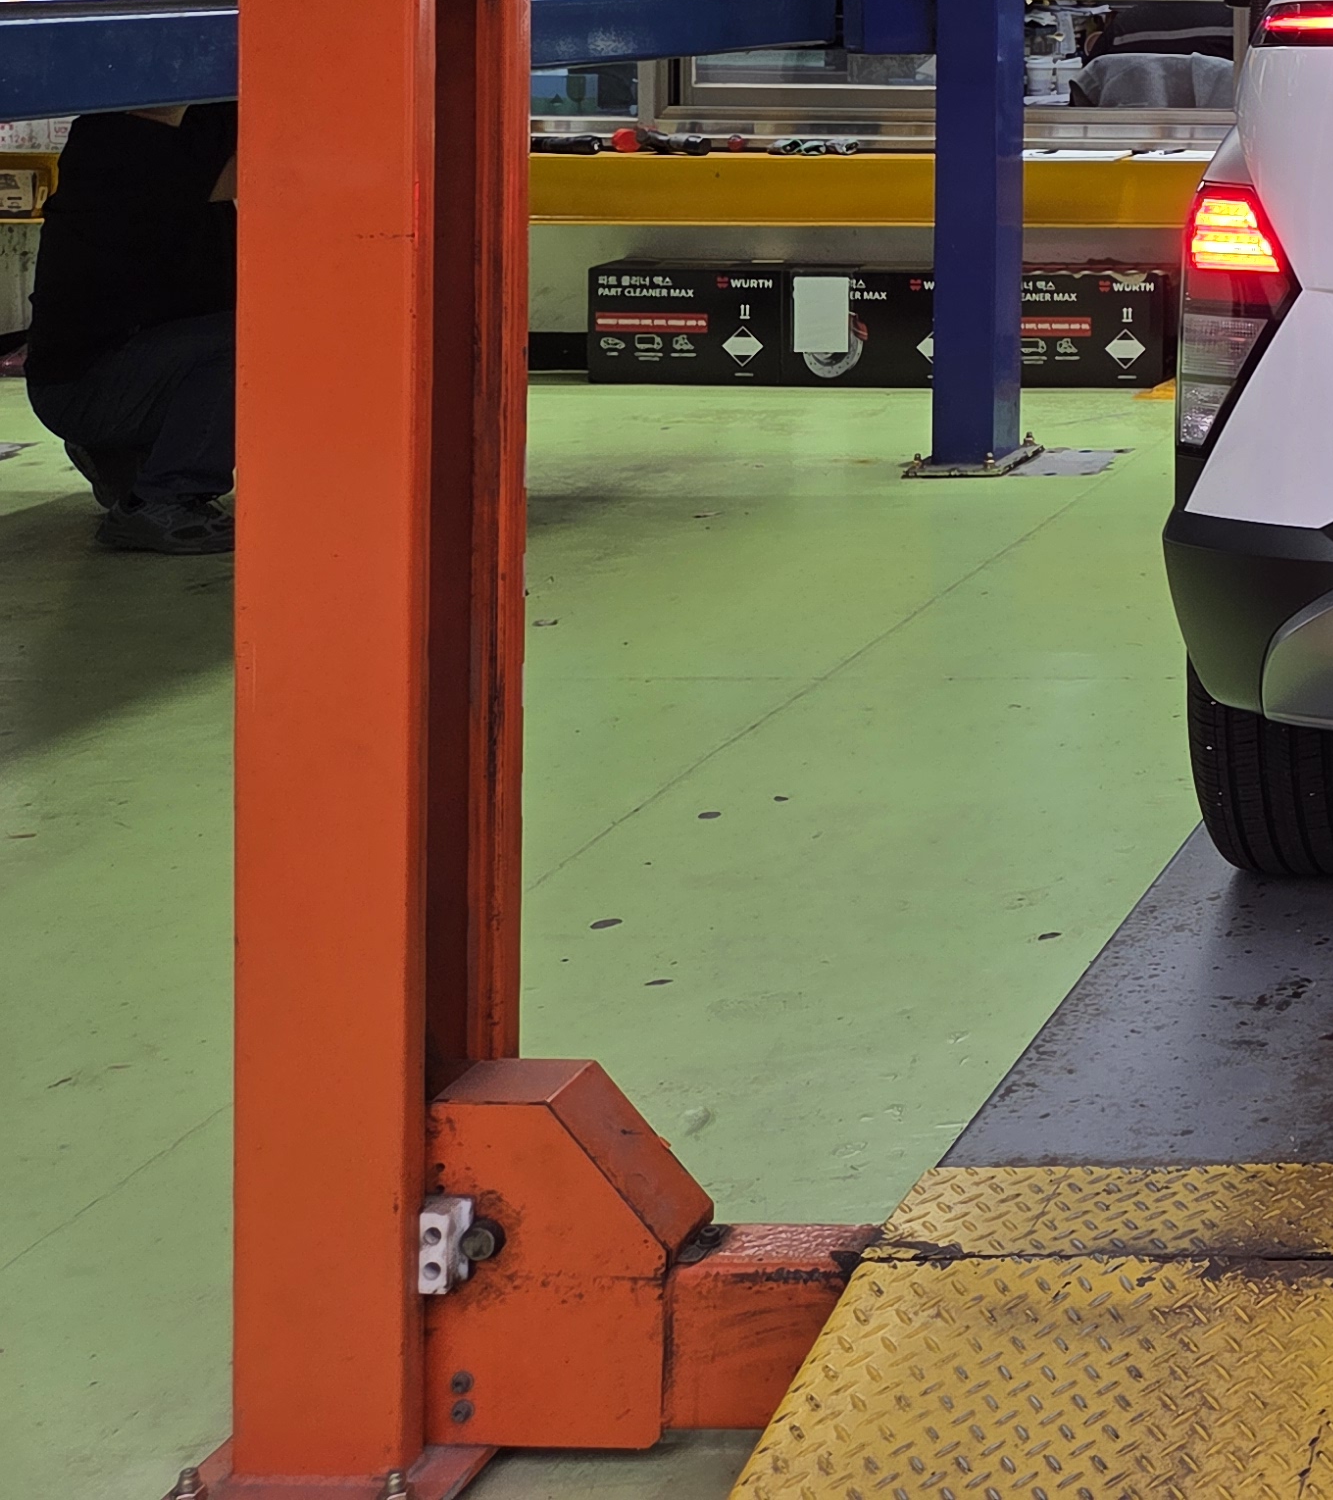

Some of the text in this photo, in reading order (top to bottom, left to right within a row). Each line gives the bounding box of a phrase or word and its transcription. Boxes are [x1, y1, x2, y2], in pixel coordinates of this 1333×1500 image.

[597, 287, 694, 298] PART CLEANER MAX
[863, 291, 887, 300] MAX
[1053, 292, 1077, 302] MAX
